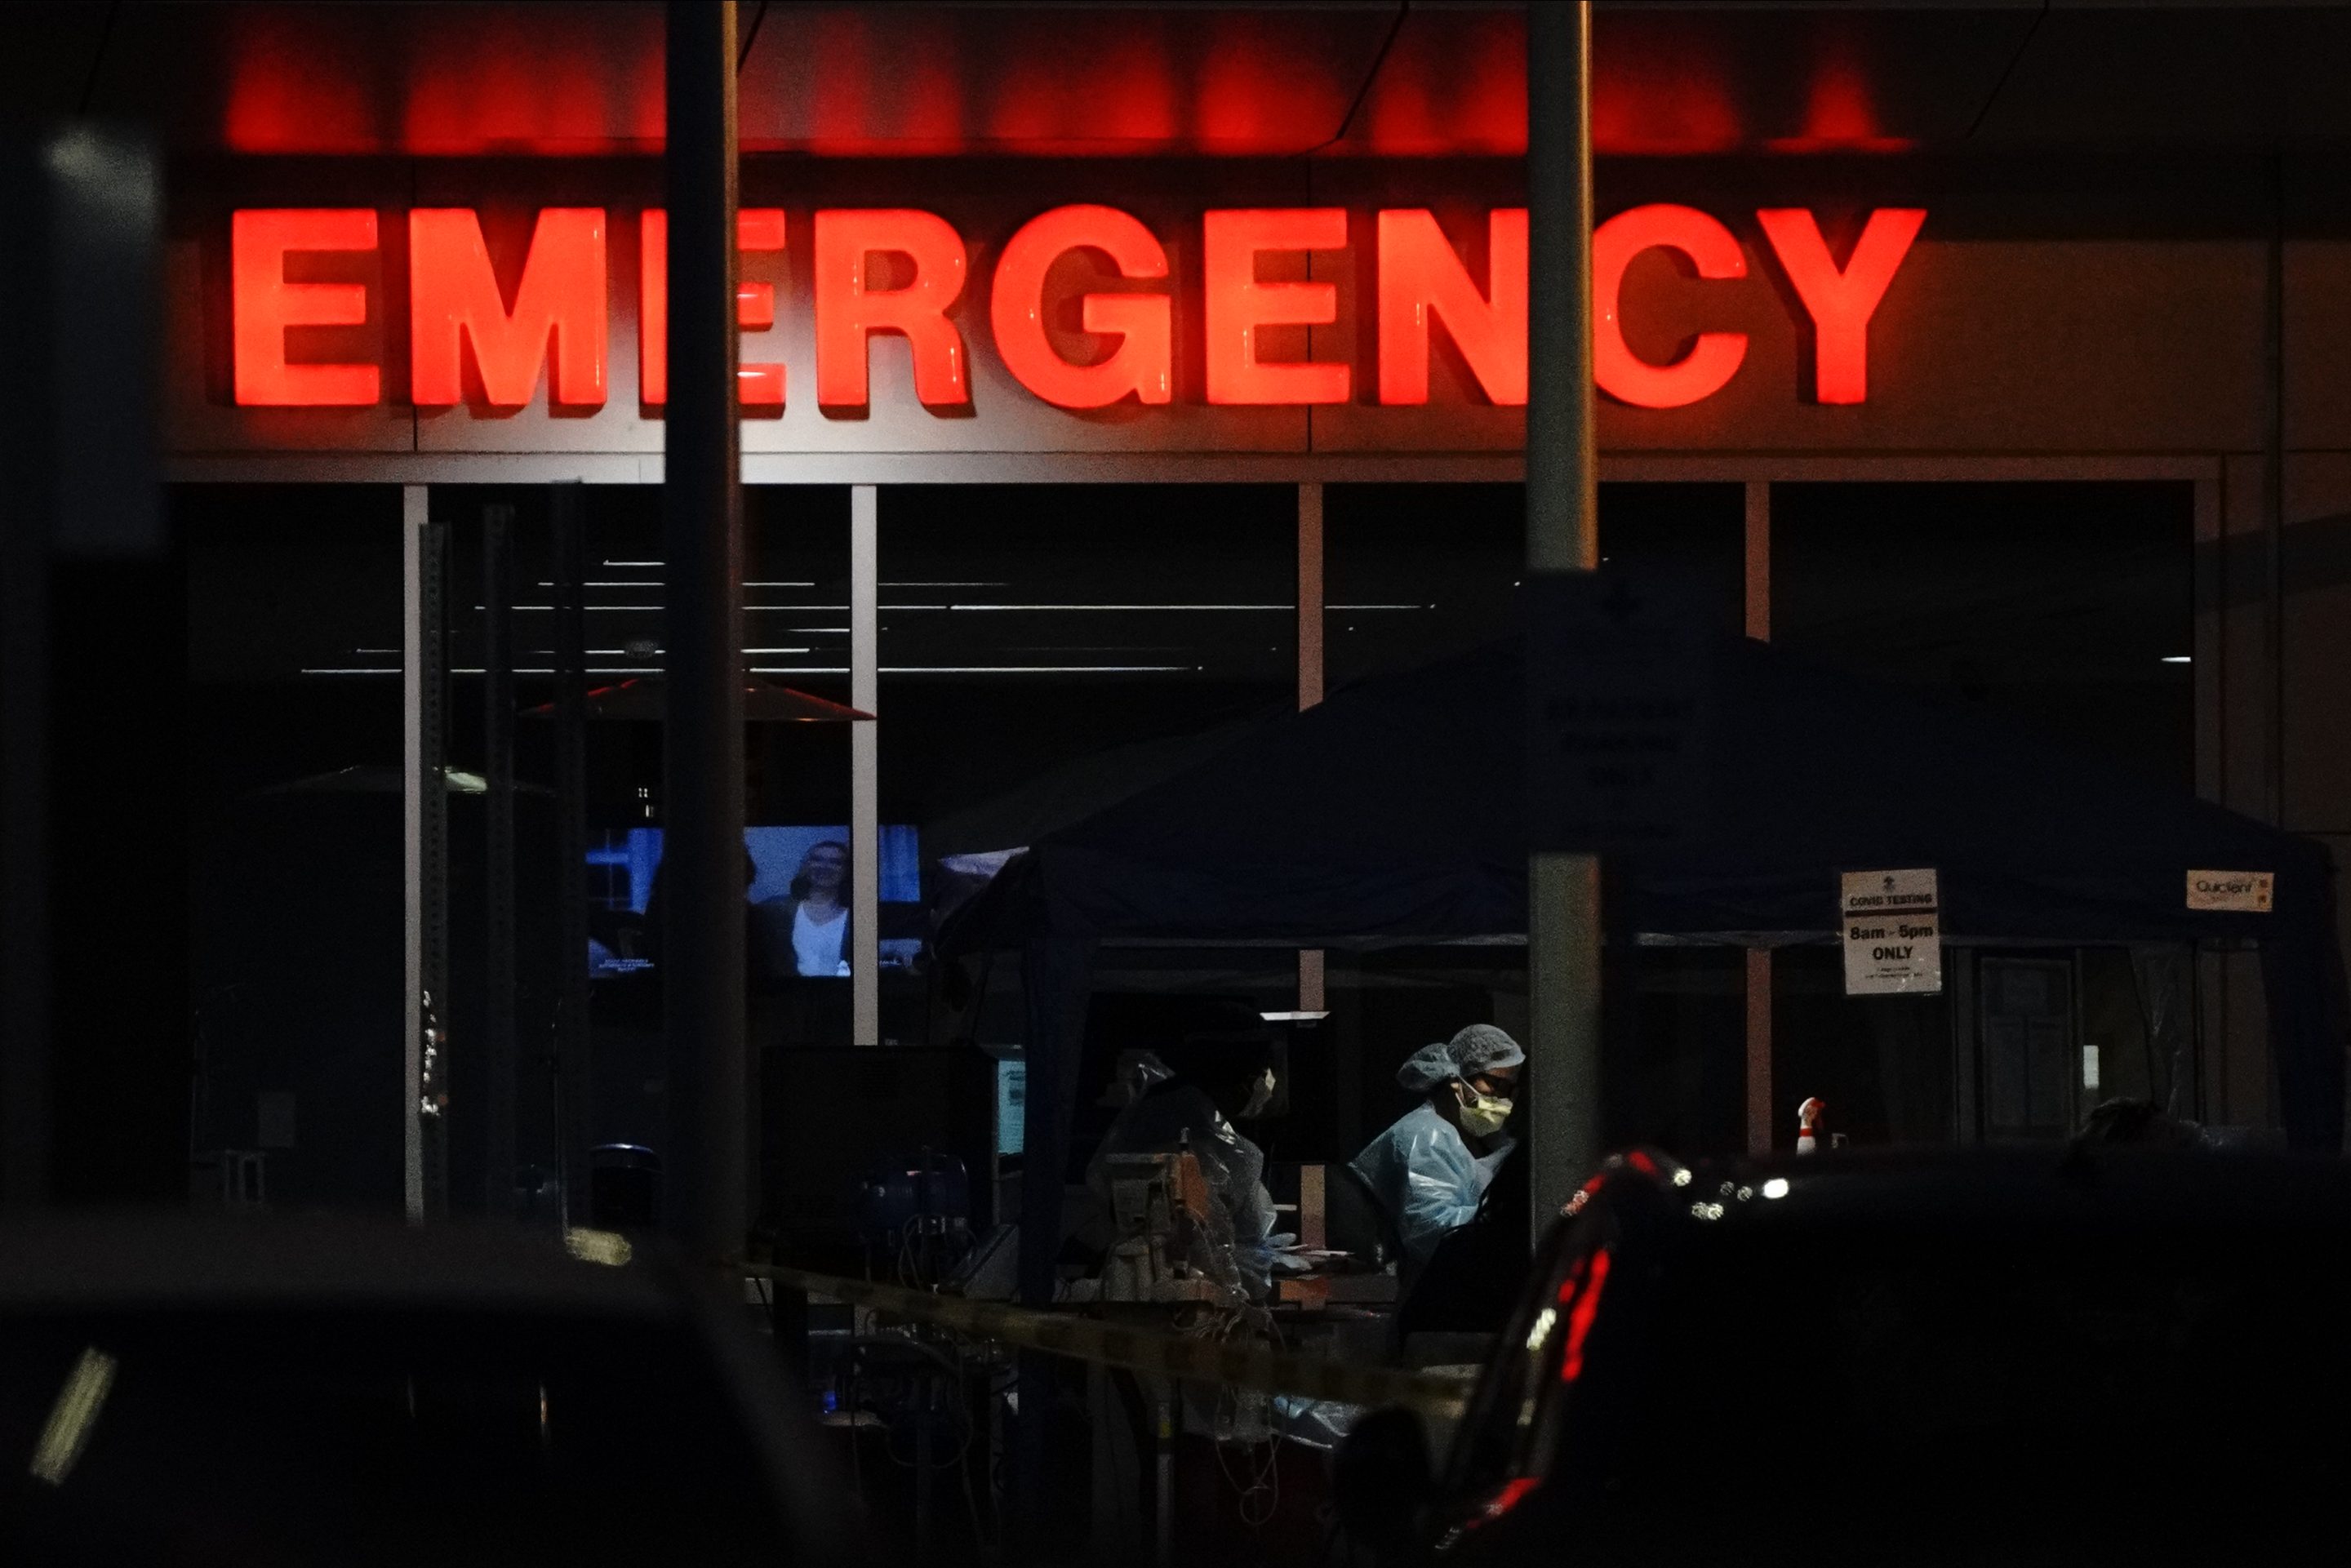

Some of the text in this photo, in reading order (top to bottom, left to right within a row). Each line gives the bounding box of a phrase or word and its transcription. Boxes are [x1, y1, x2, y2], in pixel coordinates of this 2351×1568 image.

[232, 202, 1929, 411] EMERGENCY
[1849, 893, 1933, 907] COVID TESTING
[1850, 926, 1886, 941] 8am
[1898, 924, 1934, 940] 5pm
[1872, 945, 1913, 961] ONLY
